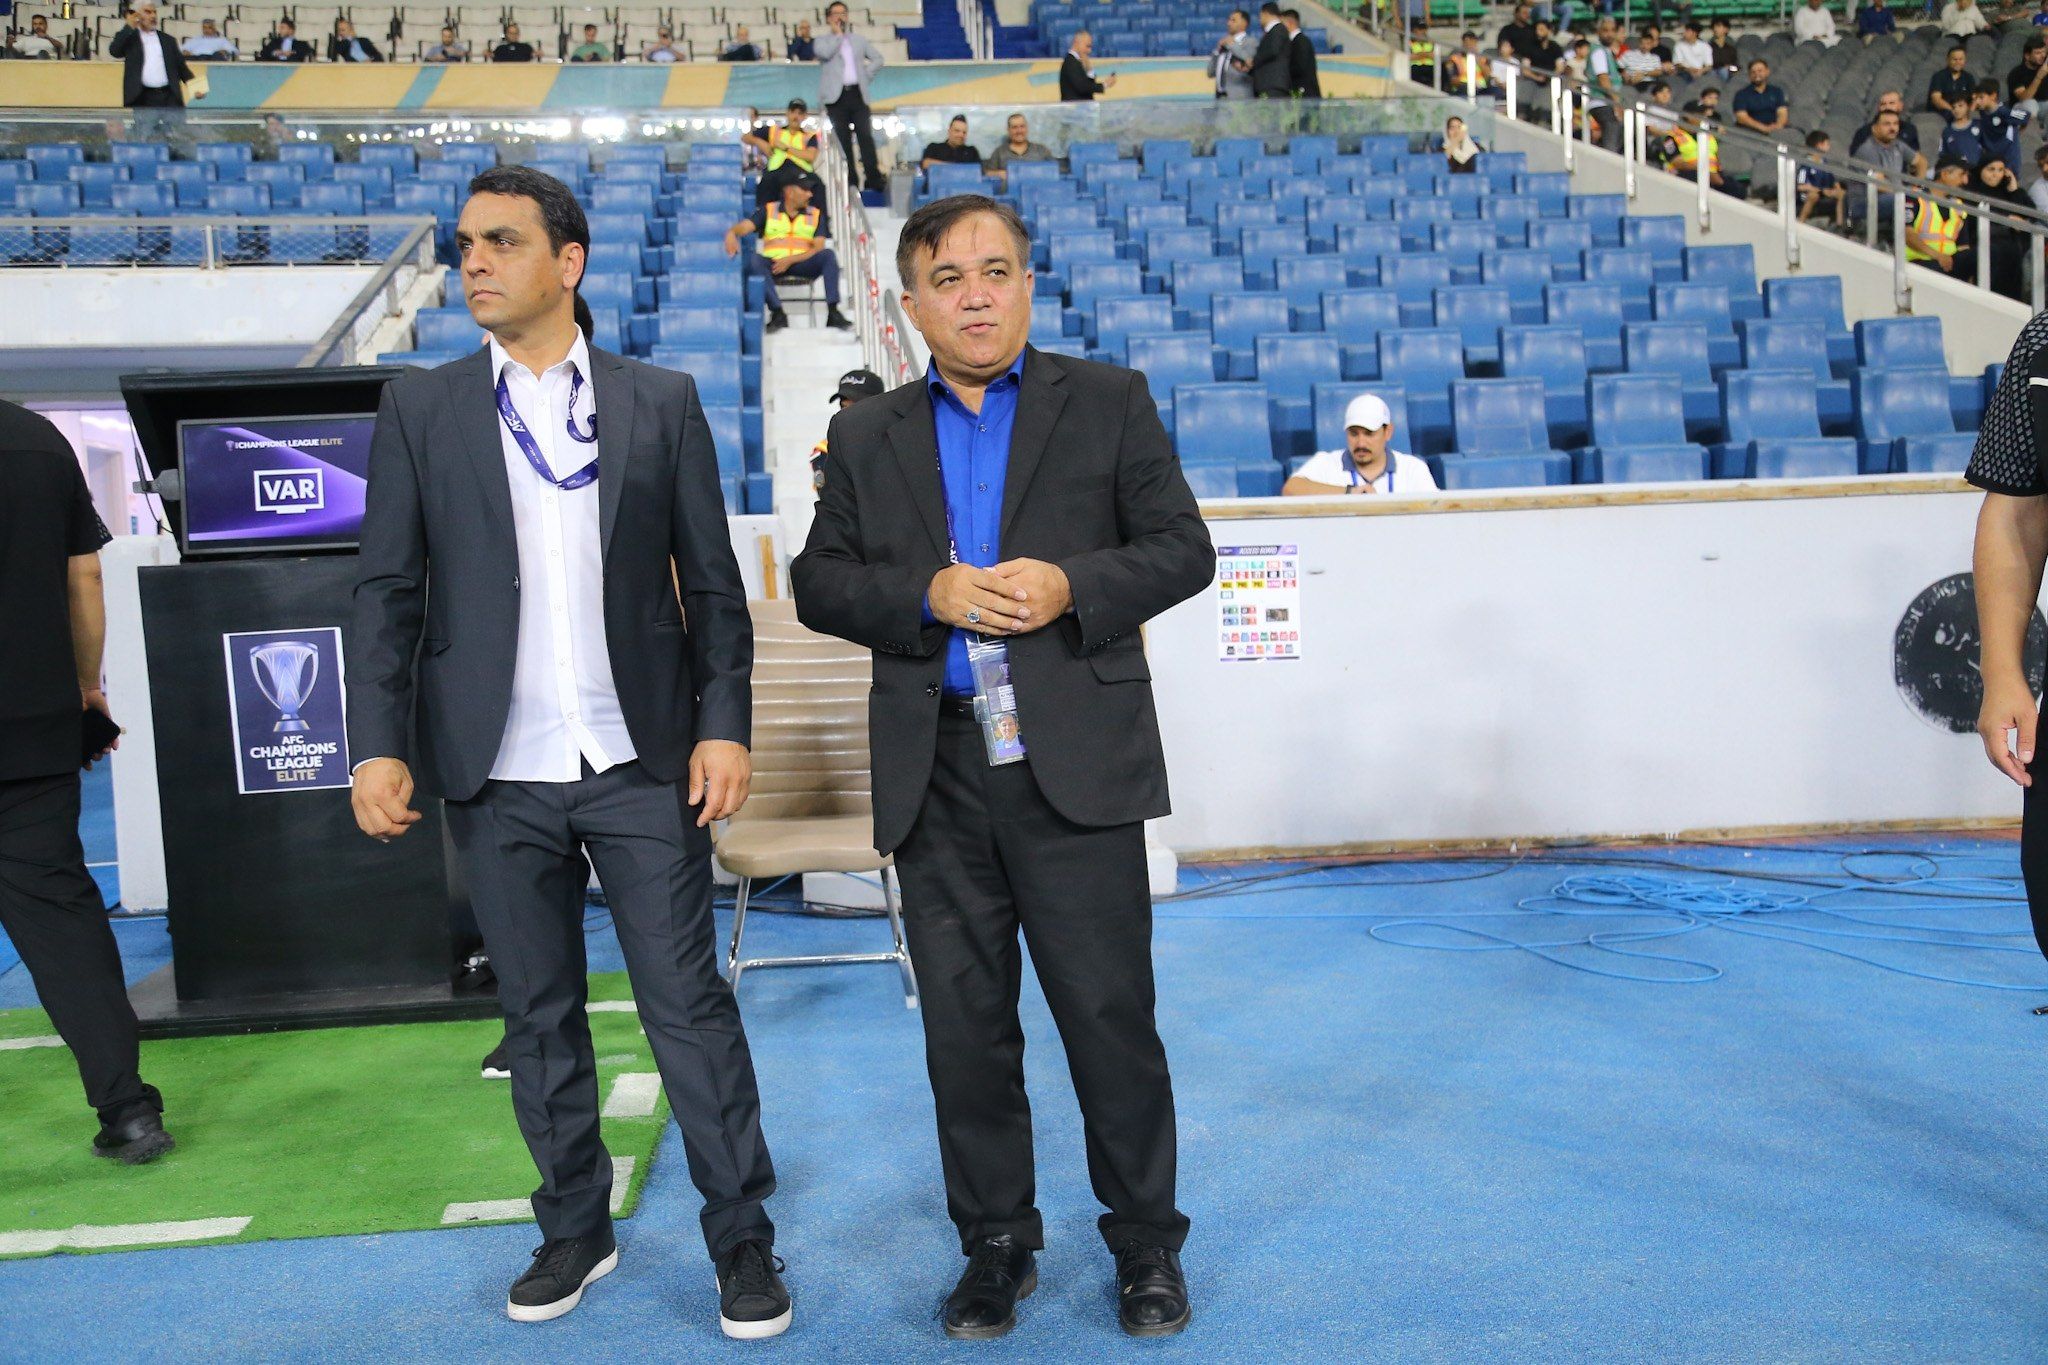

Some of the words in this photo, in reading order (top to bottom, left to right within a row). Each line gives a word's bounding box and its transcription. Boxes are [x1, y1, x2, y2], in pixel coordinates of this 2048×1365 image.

[505, 411, 525, 432] AFC
[239, 440, 287, 449] CHAMPIONS
[288, 439, 319, 447] LEAGUE
[262, 479, 316, 501] VAR
[282, 735, 304, 745] AFC
[249, 742, 338, 758] CHAMPIONS
[266, 756, 323, 771] LEAGUE
